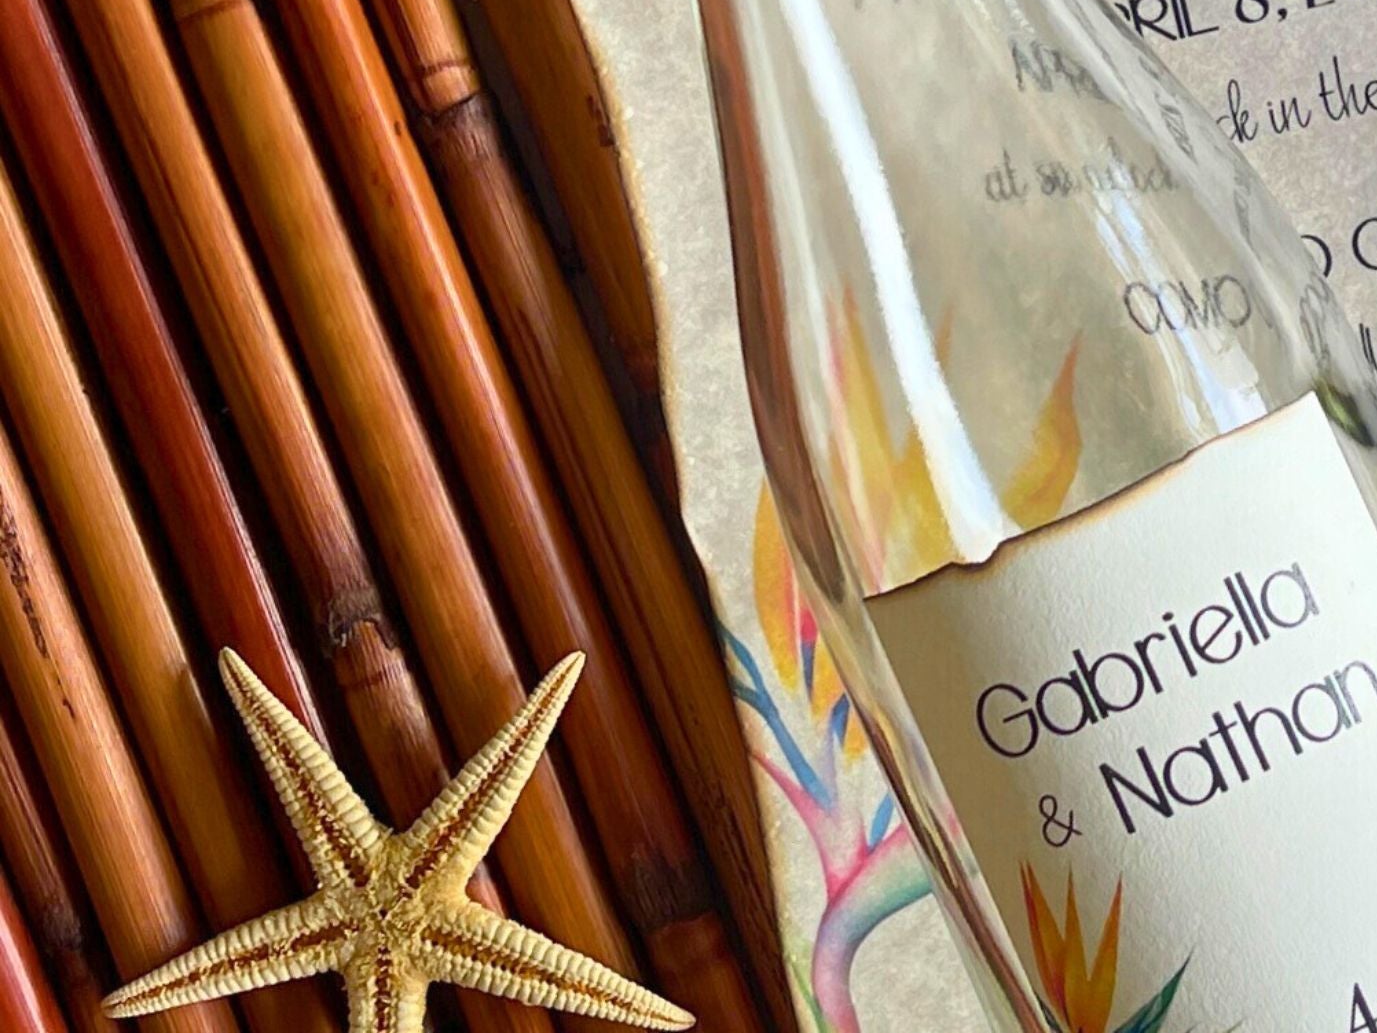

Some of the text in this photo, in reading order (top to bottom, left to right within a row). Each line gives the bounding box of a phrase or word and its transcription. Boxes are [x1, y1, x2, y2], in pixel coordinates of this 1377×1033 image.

[1266, 100, 1312, 135] in
[976, 562, 1320, 759] Gabriella
[1037, 794, 1084, 848] &
